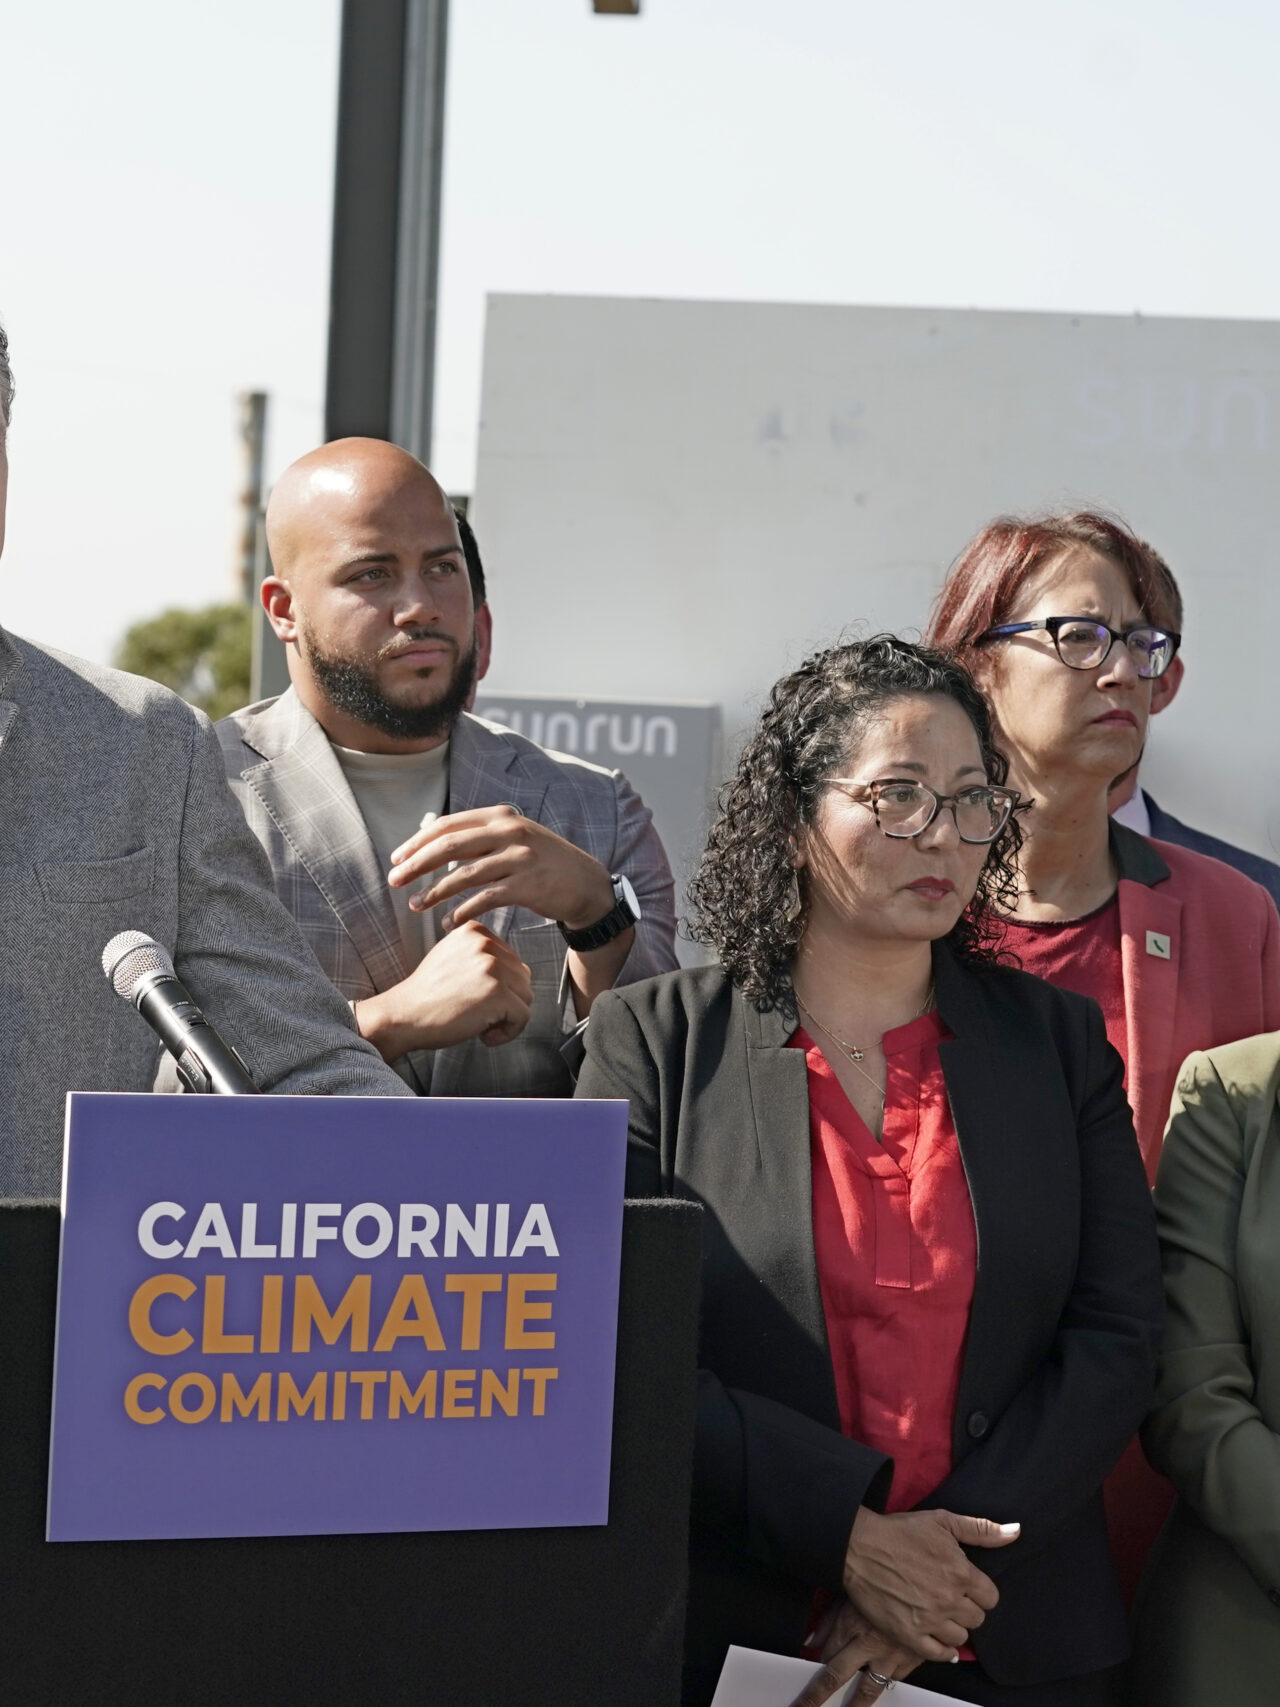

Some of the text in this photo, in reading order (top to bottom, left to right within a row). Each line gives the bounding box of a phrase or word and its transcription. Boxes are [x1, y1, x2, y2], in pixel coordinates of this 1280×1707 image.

[137, 1201, 560, 1260] CALIFORNIA
[128, 1273, 559, 1356] CLIMATE
[124, 1367, 559, 1425] COMMITMENT
